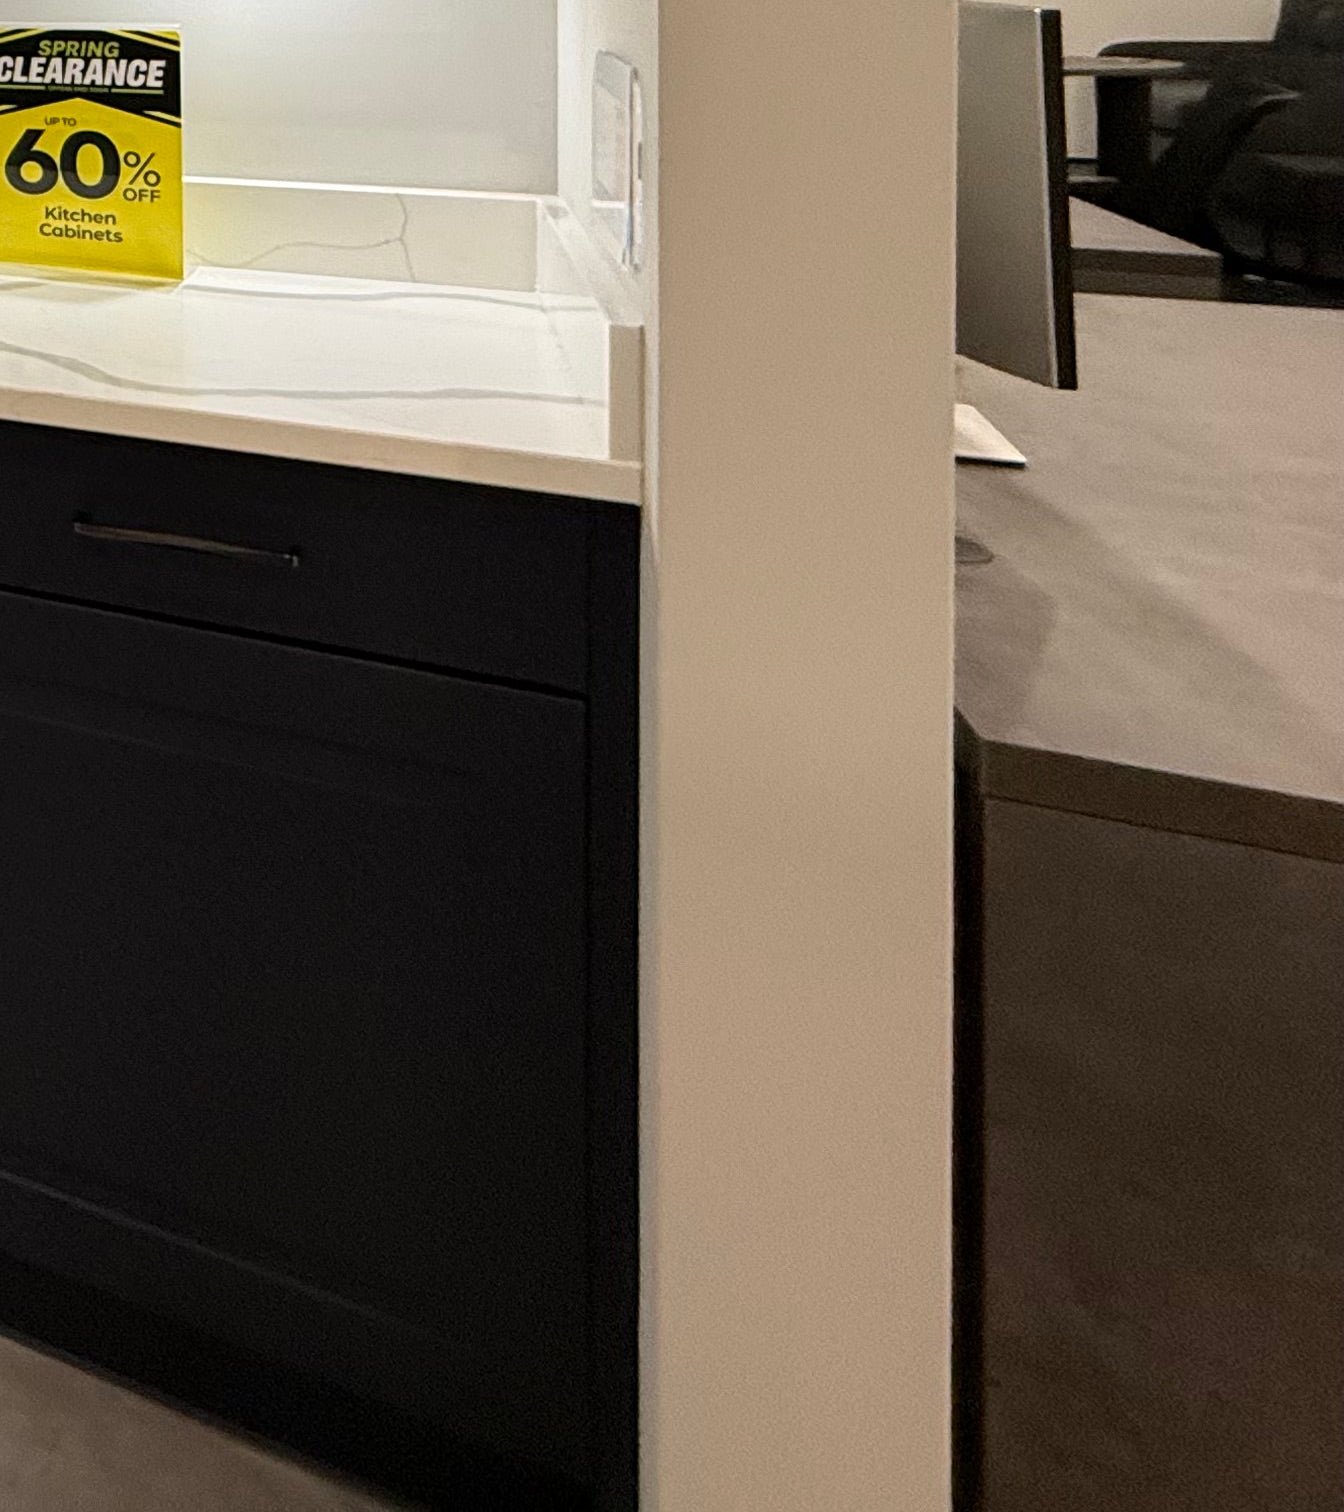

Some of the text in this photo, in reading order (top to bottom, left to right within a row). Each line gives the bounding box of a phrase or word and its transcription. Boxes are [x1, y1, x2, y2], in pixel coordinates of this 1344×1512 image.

[38, 40, 120, 58] SPRING
[44, 116, 77, 128] UP TO
[123, 188, 161, 203] OFF
[45, 205, 117, 226] Kitchen
[39, 223, 123, 243] Cabinets
